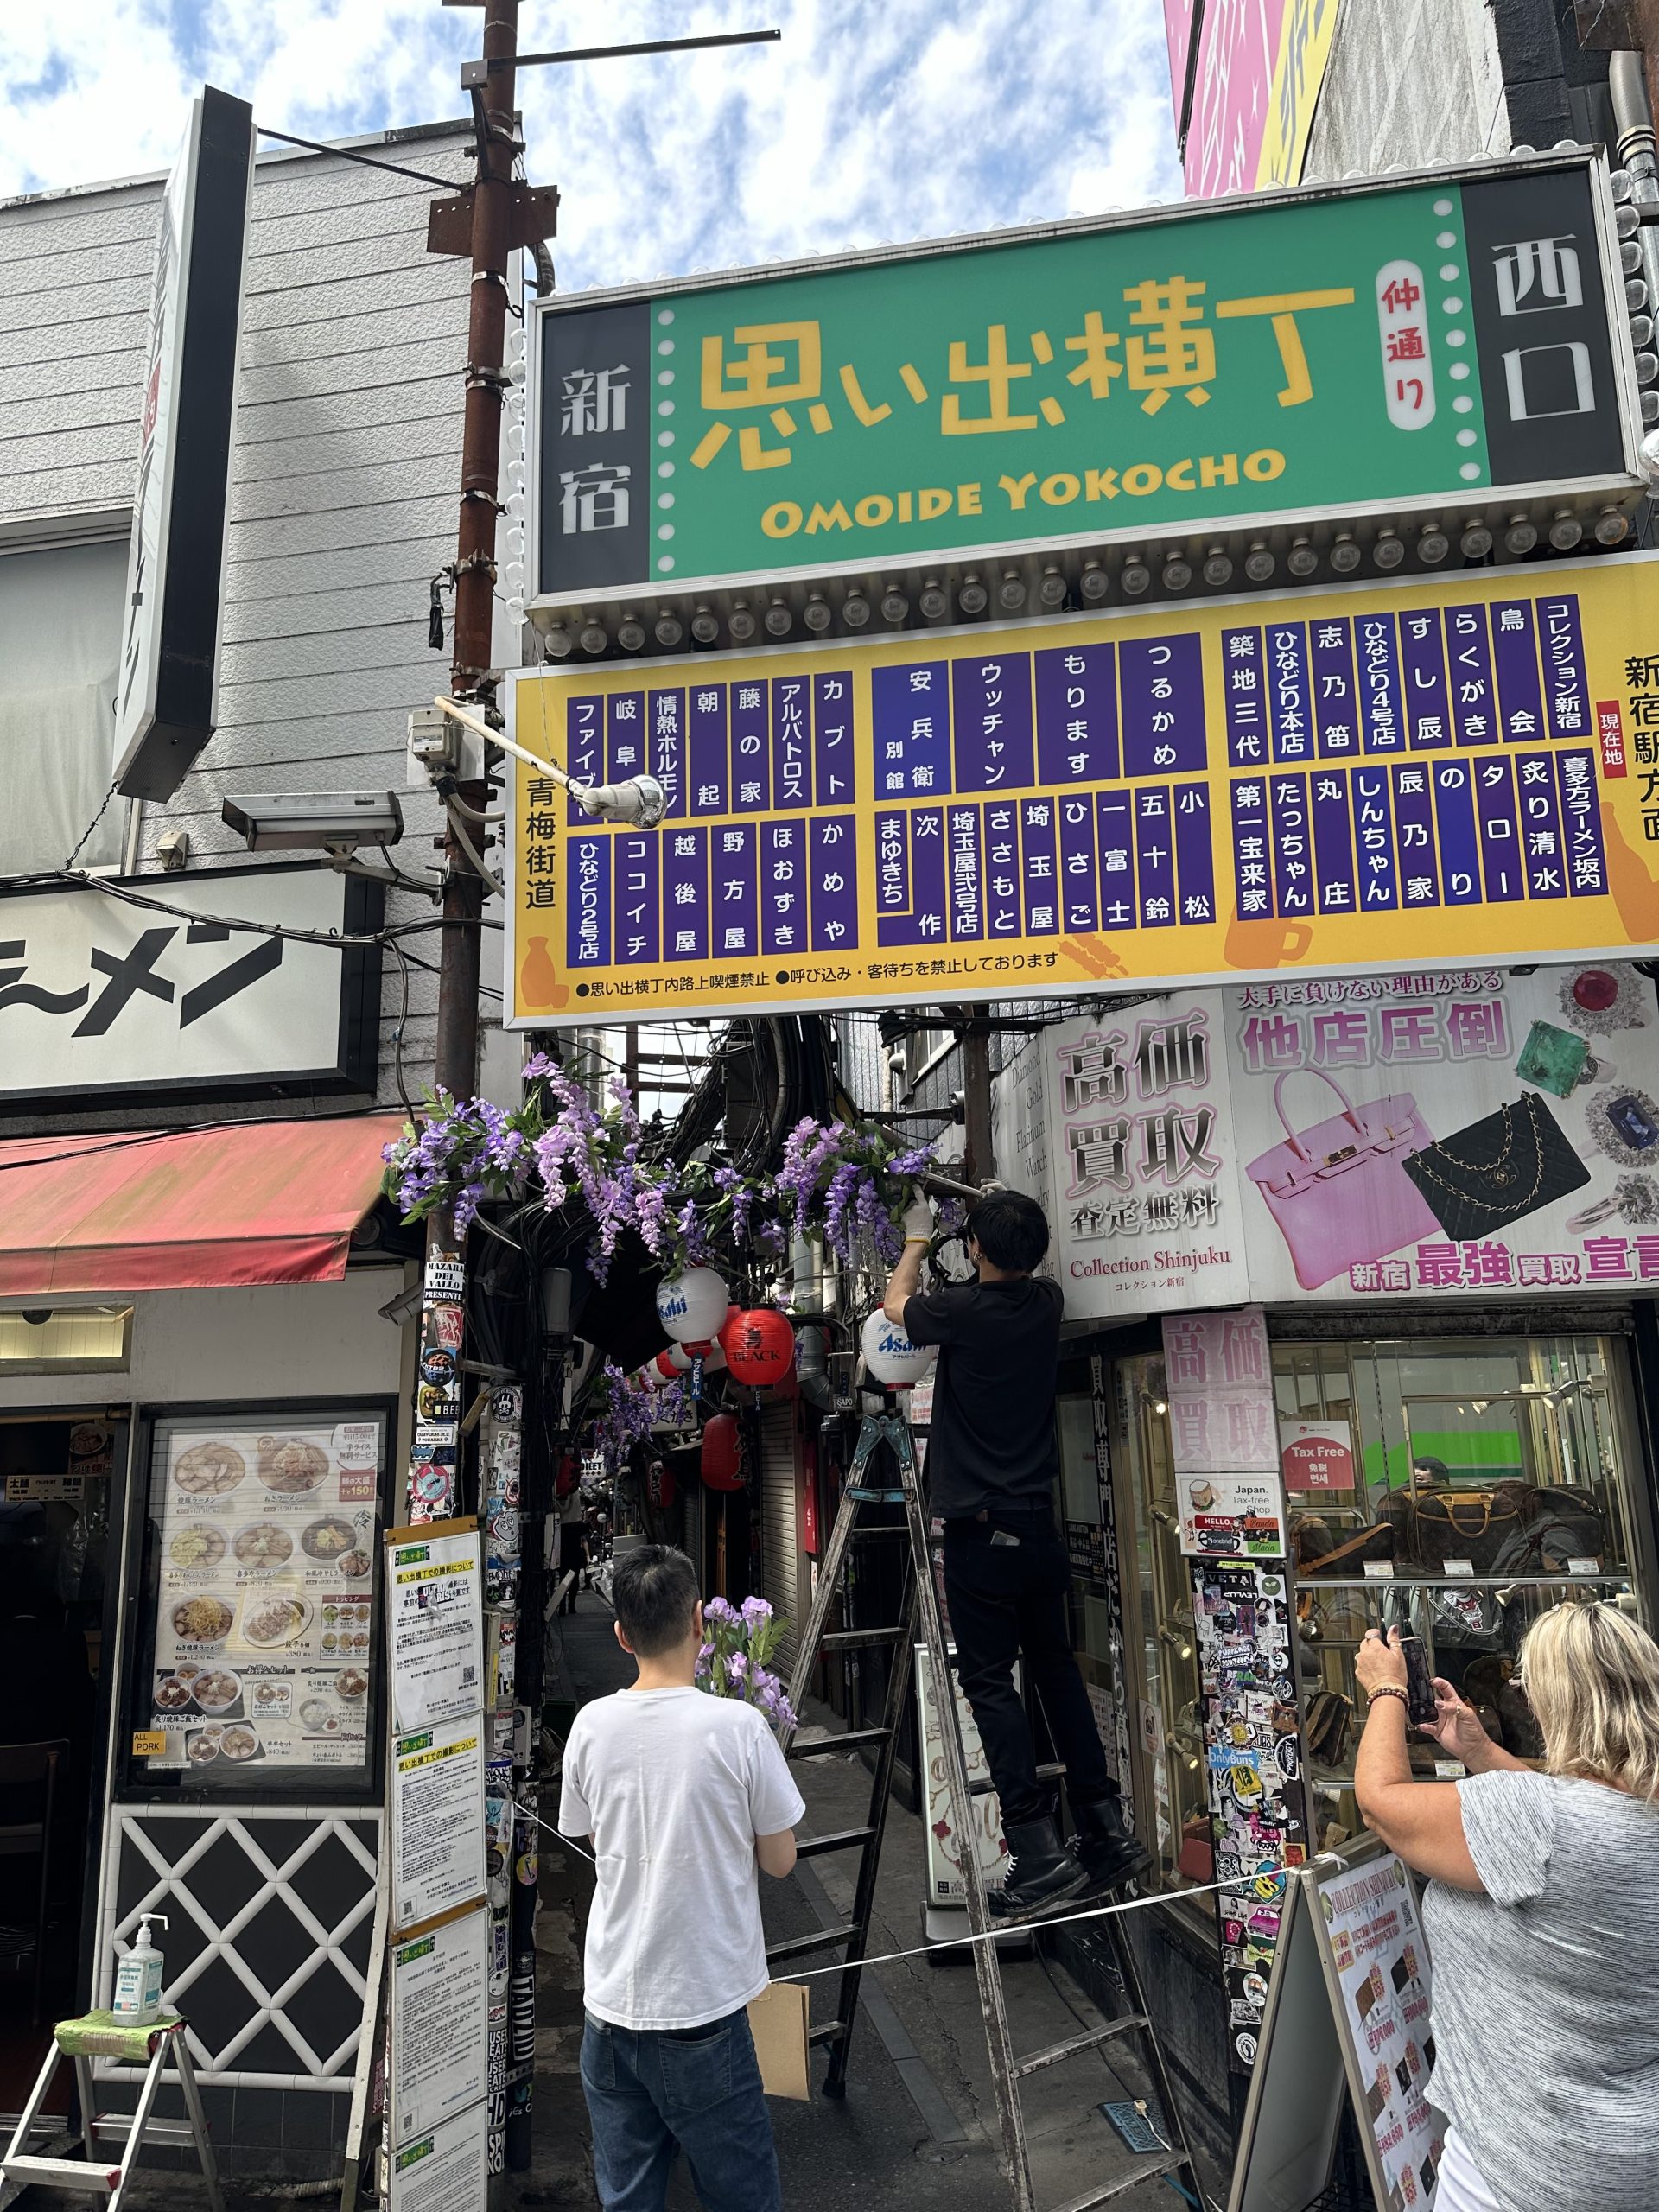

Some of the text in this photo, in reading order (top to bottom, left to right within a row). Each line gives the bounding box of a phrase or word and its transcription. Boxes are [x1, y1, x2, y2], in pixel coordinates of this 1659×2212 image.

[690, 274, 1354, 471] 思い出横丁
[1382, 276, 1424, 412] 仲通り
[1491, 232, 1598, 421] 西口
[559, 363, 632, 535] 新宿
[760, 448, 1286, 538] OMOIDE YOKOCHO
[981, 664, 1005, 784] ウッチャン
[1064, 654, 1090, 774] もります
[1148, 645, 1176, 765] つるかめ
[1230, 635, 1260, 759] 築地三代
[1274, 632, 1305, 753] ひなどり本店
[1318, 626, 1350, 747] 志乃笛
[1363, 622, 1395, 745] ひなどり4号店
[1408, 618, 1442, 740] すし辰
[1454, 613, 1487, 736] らくがき
[1500, 608, 1535, 731] 鳥会
[1547, 605, 1581, 729] コレクション新宿
[576, 703, 596, 816] ファイブ
[615, 699, 637, 766] 岐阜
[697, 691, 720, 806] 朝起
[739, 688, 761, 803] 藤の家
[780, 683, 803, 798] アルバトロス
[823, 679, 845, 796] カブト
[886, 741, 904, 790] 別館
[910, 671, 934, 788] 安兵衛
[1600, 714, 1623, 765] 現在地
[526, 778, 556, 909] 青梅街道
[880, 818, 903, 904] まゆきち
[916, 816, 941, 936] 次作
[953, 812, 977, 934] 埼玉屋弐号店
[990, 809, 1014, 931] ささもと
[1027, 805, 1054, 928] 埼玉屋
[1065, 803, 1091, 925] ひさご
[1103, 804, 1130, 922] 一富士
[1141, 795, 1170, 919] 五十鈴
[1180, 791, 1210, 918] 小松
[1236, 785, 1268, 911] 第一宝来家
[1277, 781, 1307, 907] たっちゃん
[1316, 778, 1350, 906] 丸庄
[1358, 774, 1391, 901] しんちゃん
[1398, 770, 1433, 899] 辰乃家
[1440, 767, 1473, 896] のり
[1483, 764, 1511, 893] タロー
[1522, 760, 1560, 892] 炙り清水
[1562, 757, 1601, 889] 喜多方ラーメン坂内
[578, 842, 599, 960] ひなどり2号店
[626, 841, 647, 957] ココイチ
[674, 835, 696, 952] 越後屋
[723, 832, 746, 949] 野方屋
[773, 828, 795, 946] ほおずき
[823, 824, 845, 941] かめや
[1243, 970, 1502, 1007] 大手に負けない理由がある
[1243, 1001, 1507, 1069] 他店圧倒
[1012, 1051, 1041, 1089] Diamond
[1026, 1077, 1043, 1109] Gold
[1062, 1016, 1209, 1114] 高価
[1016, 1120, 1046, 1153] Platinum
[1026, 1149, 1047, 1178] Watch
[1068, 1103, 1220, 1198] 買取
[1035, 1188, 1050, 1215] elry
[1071, 1184, 1218, 1241] 査定無料
[424, 1290, 462, 1300] PRESENTE
[428, 1262, 464, 1273] MAZARA
[429, 1280, 460, 1290] VALLO
[435, 1272, 455, 1281] DEL
[1071, 1245, 1230, 1279] Collection Shinjuku
[1116, 1276, 1185, 1291] コレクション新宿
[692, 1358, 701, 1395] アサヒビール
[734, 1351, 780, 1362] BLACK
[1167, 1318, 1263, 1383] 高価
[1173, 1398, 1272, 1461] 買取
[1291, 1446, 1345, 1458] Tax Free
[1308, 1463, 1328, 1472] 免税
[1310, 1474, 1329, 1484] 면세
[1205, 1517, 1230, 1526] HELLO
[1231, 1496, 1270, 1504] Tax-free
[1246, 1505, 1271, 1515] Shop
[137, 1742, 160, 1751] PORK
[1210, 1752, 1255, 1765] OnlyBuns
